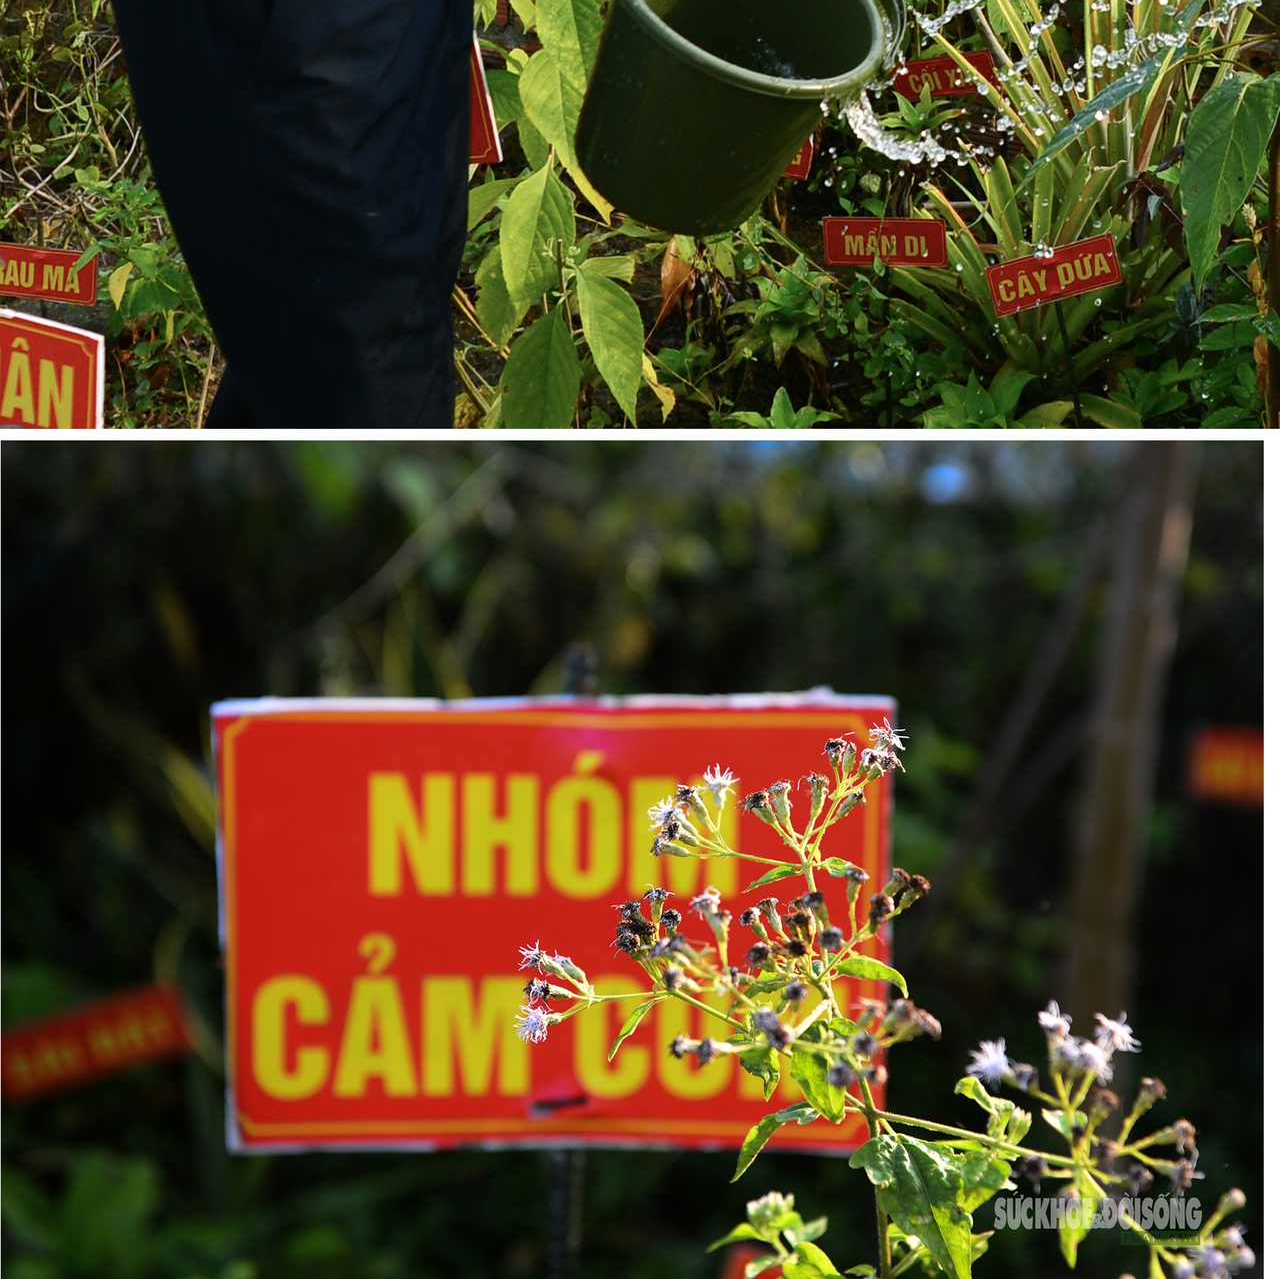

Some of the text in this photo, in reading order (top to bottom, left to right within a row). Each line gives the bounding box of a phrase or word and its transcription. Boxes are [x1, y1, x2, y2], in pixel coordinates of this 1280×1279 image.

[844, 227, 897, 256] MẦN
[999, 253, 1111, 302] CÂY DỨA
[0, 336, 75, 429] ÂN
[368, 750, 738, 900] NHÓM
[251, 932, 531, 1101] CẢM
